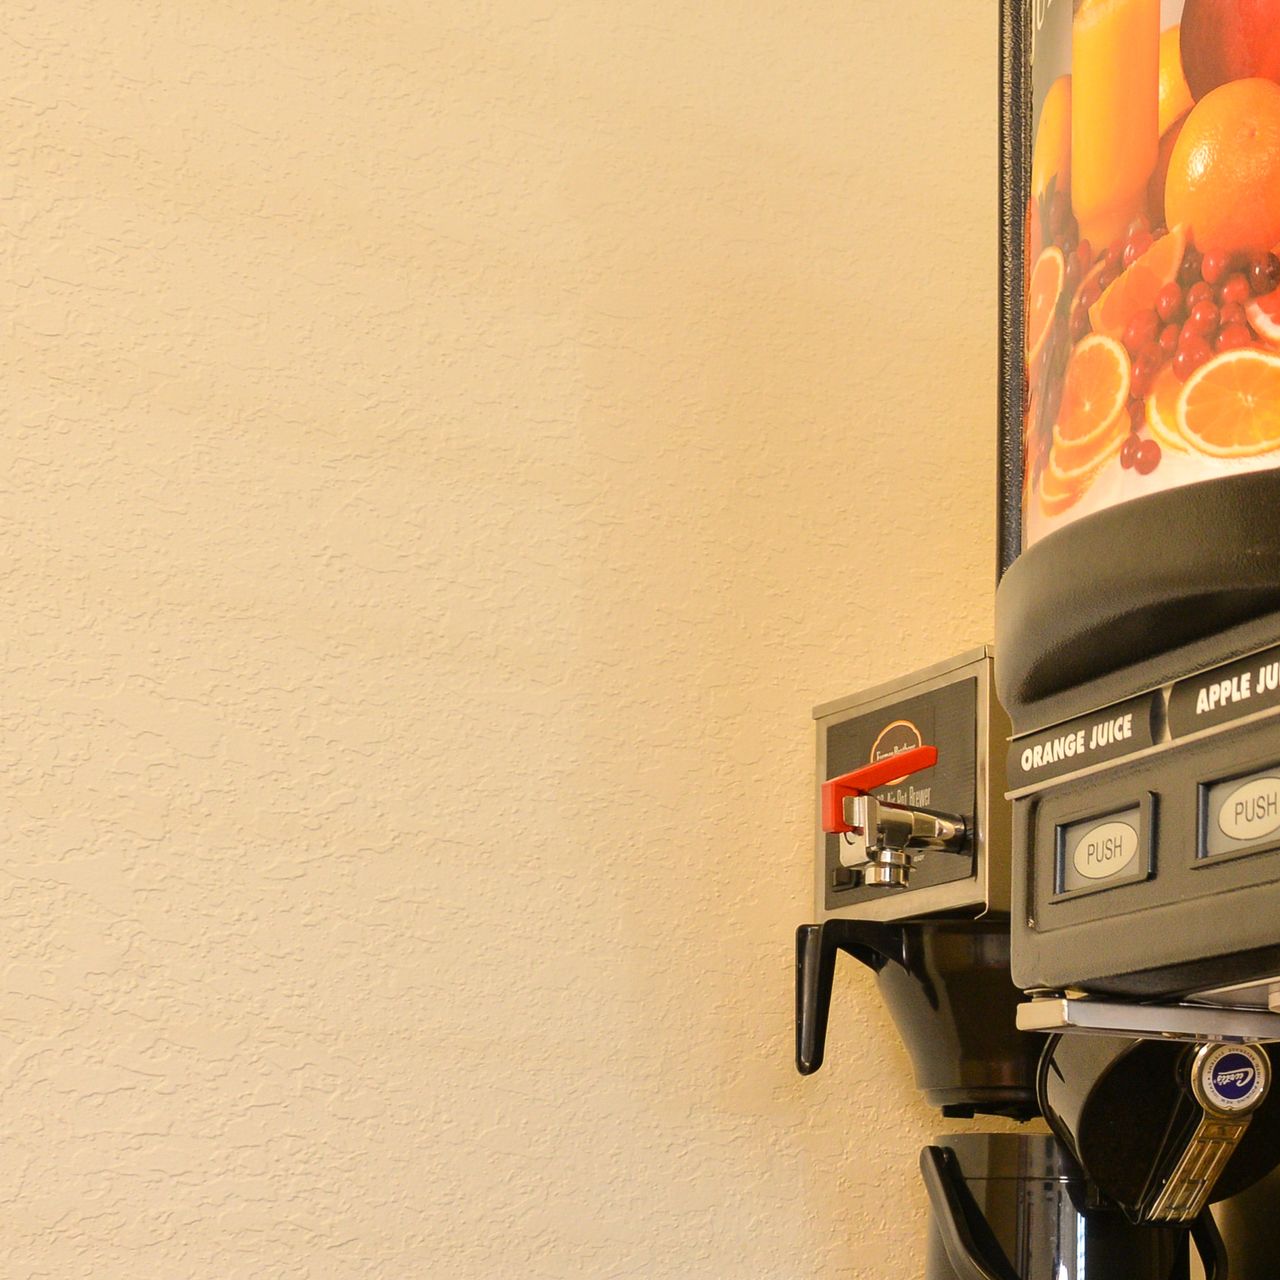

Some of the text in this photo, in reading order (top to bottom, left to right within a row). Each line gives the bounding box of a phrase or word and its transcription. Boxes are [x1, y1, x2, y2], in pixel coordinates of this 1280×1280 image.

[1196, 673, 1250, 714] APPLE
[1021, 713, 1132, 771] ORANGE JUICE
[1235, 792, 1277, 825] PUSH
[1087, 837, 1122, 865] PUSH
[1216, 1067, 1254, 1087] Curtis
